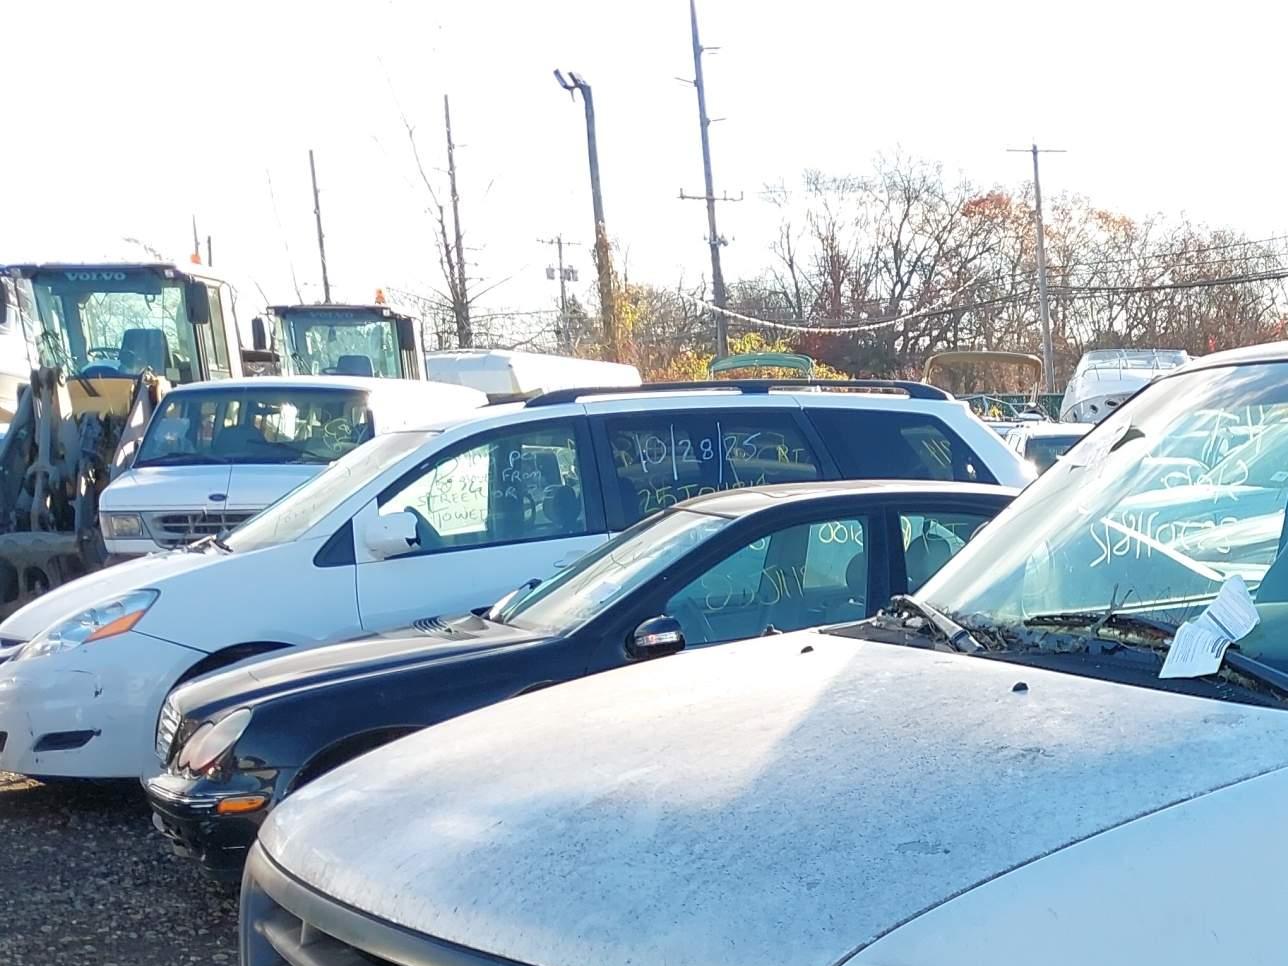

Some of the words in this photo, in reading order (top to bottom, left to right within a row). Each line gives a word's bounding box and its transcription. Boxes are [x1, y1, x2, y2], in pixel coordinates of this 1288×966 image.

[64, 271, 126, 281] VOLVO
[634, 422, 761, 484] 10/28/25
[502, 468, 542, 482] FROM
